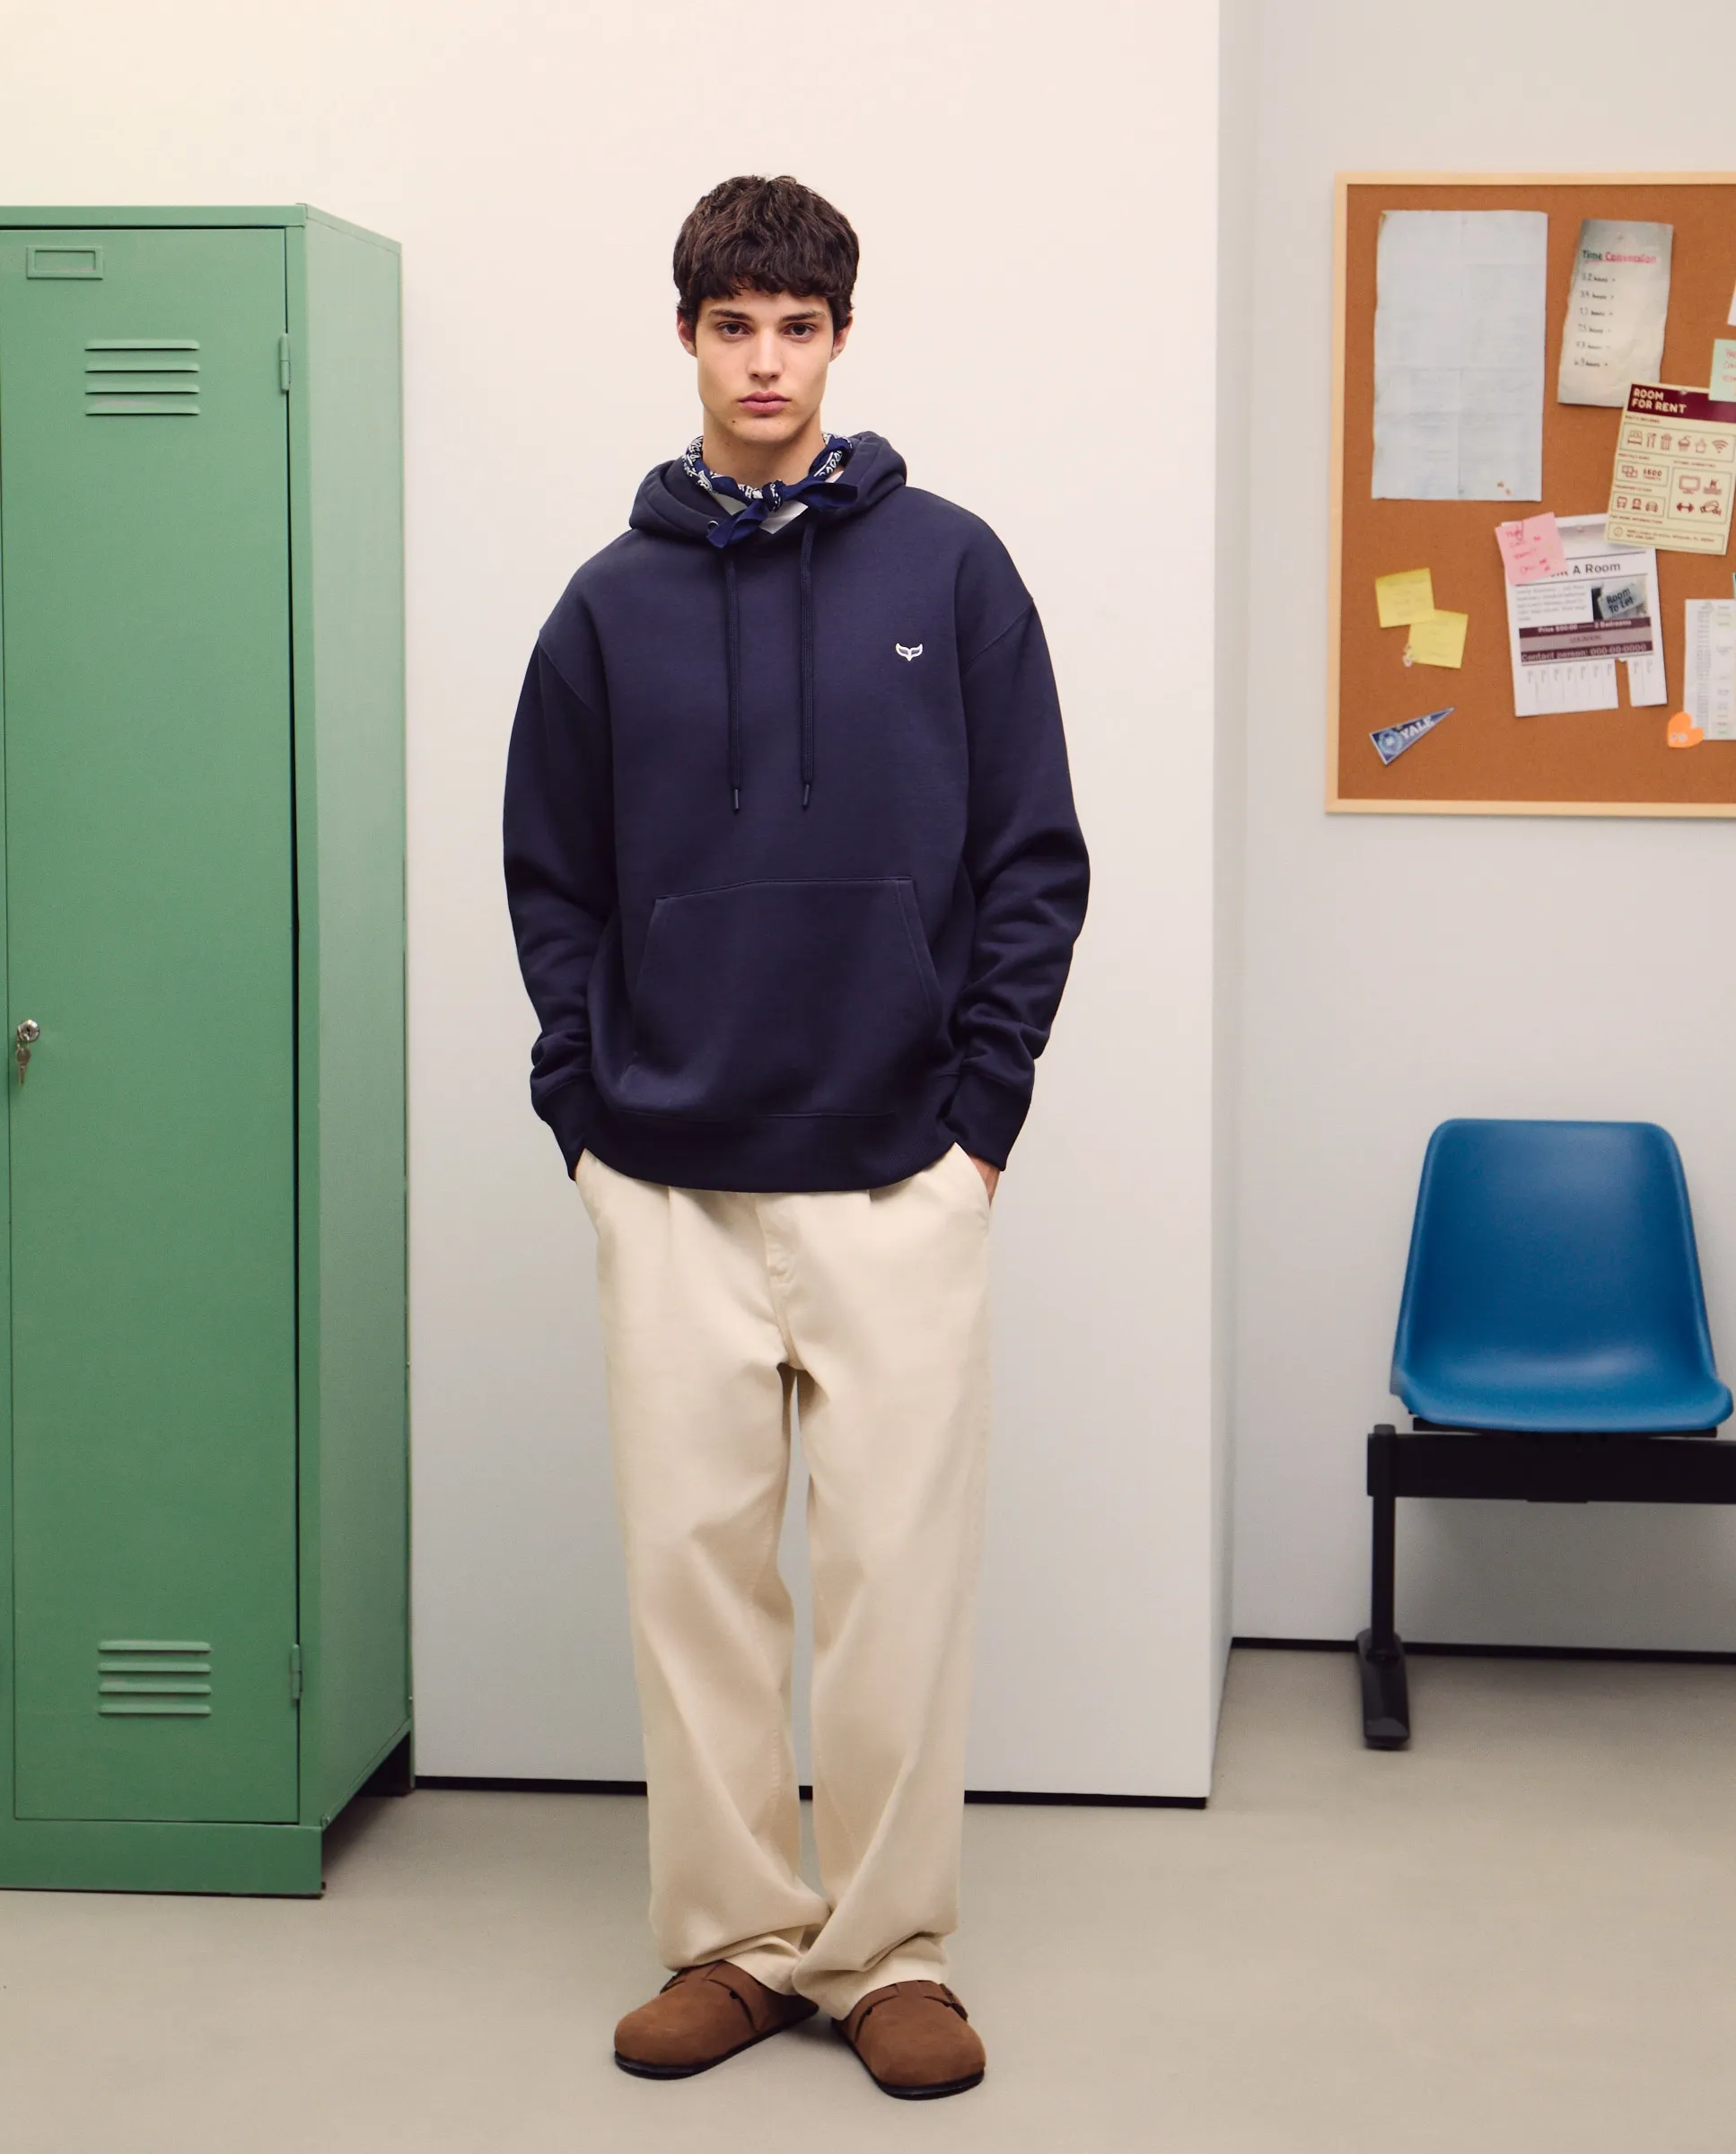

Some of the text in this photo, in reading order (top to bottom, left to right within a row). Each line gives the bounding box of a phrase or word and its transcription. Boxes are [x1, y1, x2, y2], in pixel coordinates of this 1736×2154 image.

[1583, 250, 1602, 261] Time
[1634, 387, 1664, 401] ROOM
[1631, 398, 1688, 414] FOR RENT
[1573, 565, 1582, 574] A
[1585, 563, 1621, 574] Room
[1606, 588, 1631, 605] Room
[1608, 603, 1619, 614] To
[1521, 652, 1555, 662] Contact
[1399, 715, 1436, 740] YALE
